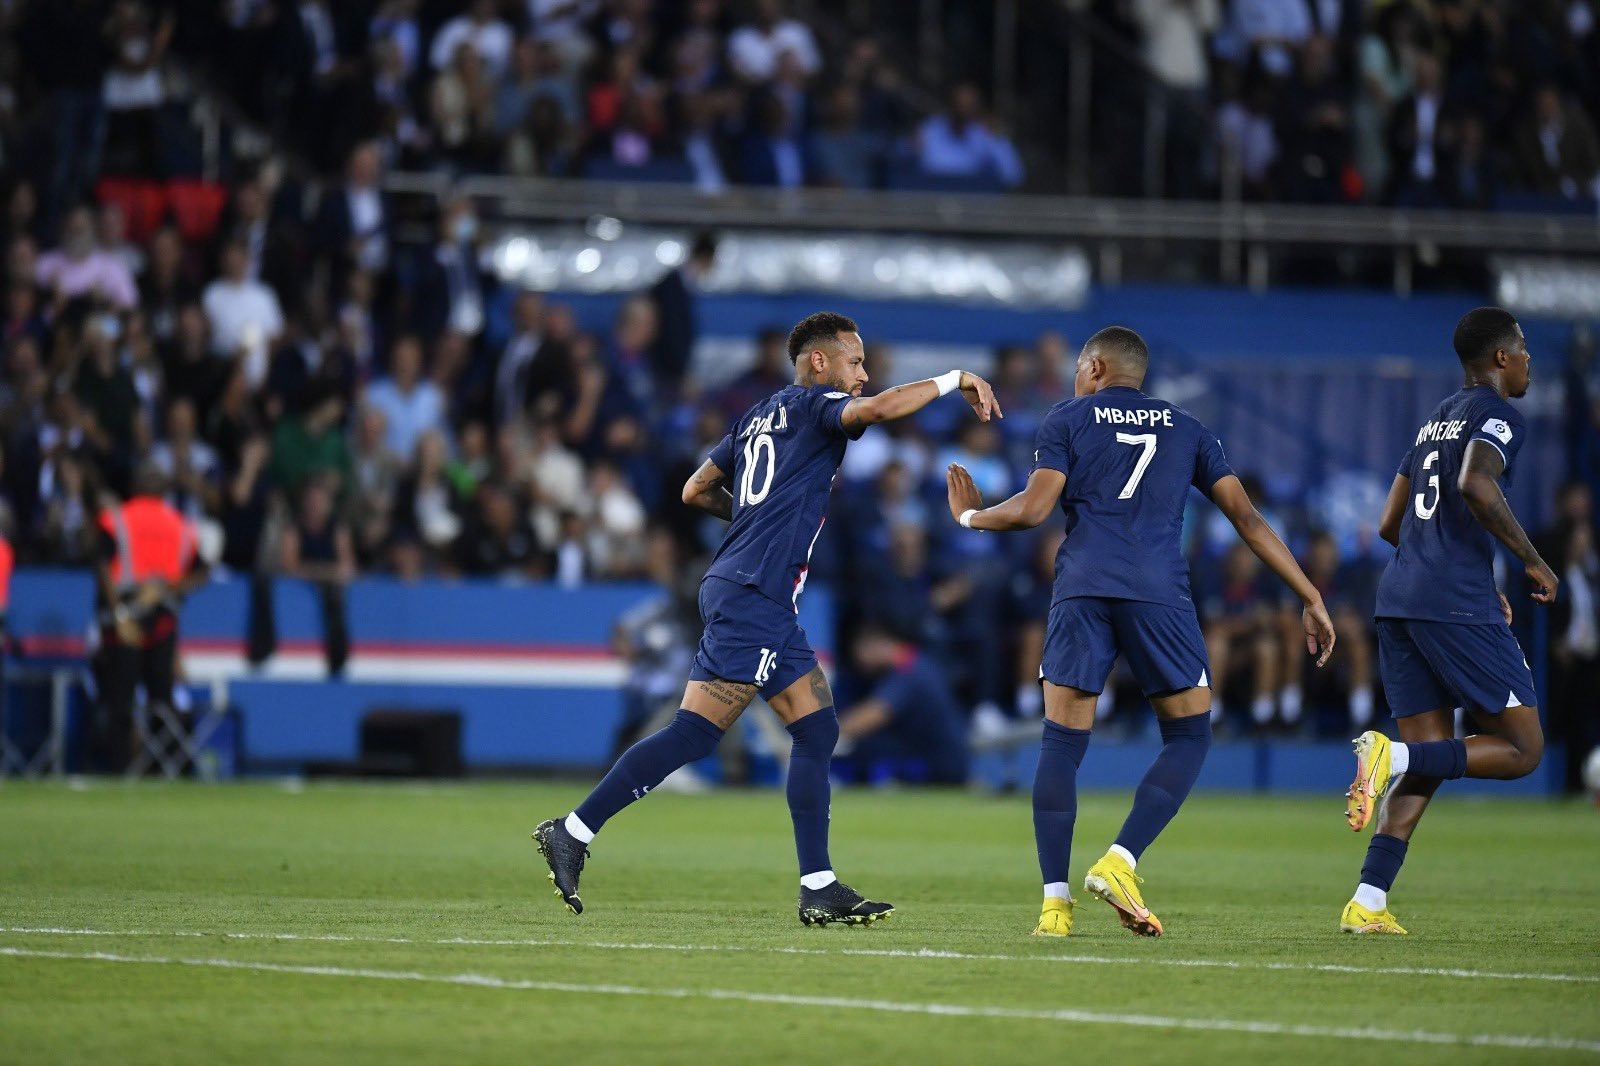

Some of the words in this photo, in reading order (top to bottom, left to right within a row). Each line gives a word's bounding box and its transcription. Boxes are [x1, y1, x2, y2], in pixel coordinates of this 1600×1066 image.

[1094, 406, 1174, 427] MBAPPÉ
[739, 434, 776, 507] 10
[1116, 432, 1157, 500] 7
[1415, 451, 1440, 520] 3
